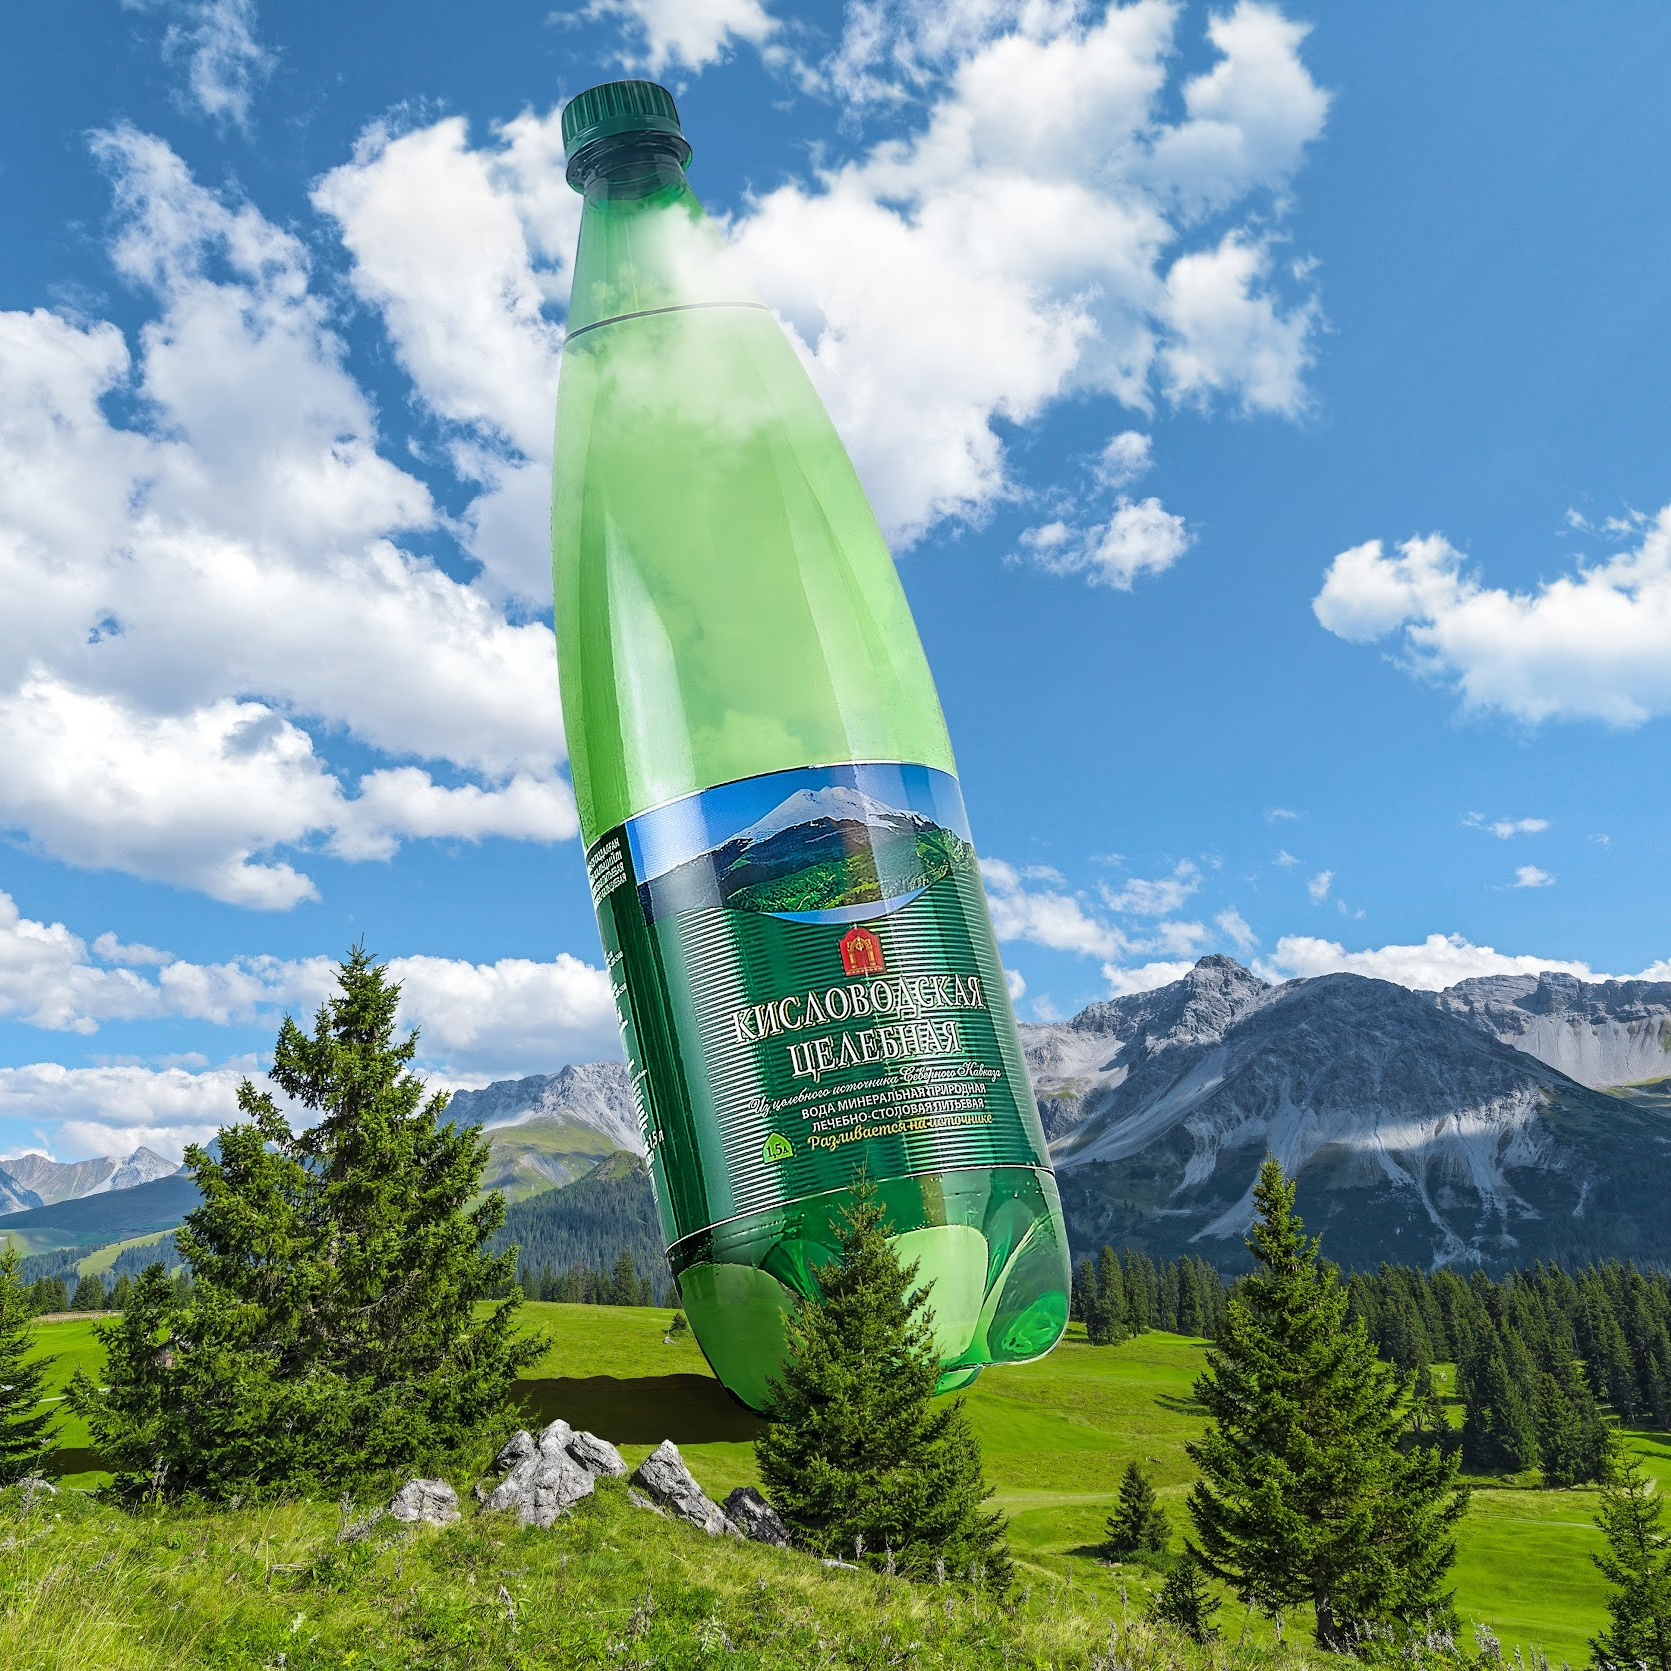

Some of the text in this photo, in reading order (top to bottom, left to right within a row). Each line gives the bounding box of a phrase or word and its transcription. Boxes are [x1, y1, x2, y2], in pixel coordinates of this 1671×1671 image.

[731, 974, 985, 1043] КИСЛОВОДСКАЯ
[786, 1020, 963, 1083] ЦЕЛЕБНАЯ
[772, 1087, 830, 1112] целебного
[832, 1076, 899, 1096] источника
[957, 1062, 1001, 1082] Кавказа
[801, 1083, 987, 1119] ВОДА МИНЕРАЛЬНАЯ ПРИРОДНАЯ
[807, 1113, 993, 1151] Разливается на источнике
[812, 1098, 984, 1133] ЛЕЧЕБНО-СТОЛОВАЯ ПИТЬЕВАЯ
